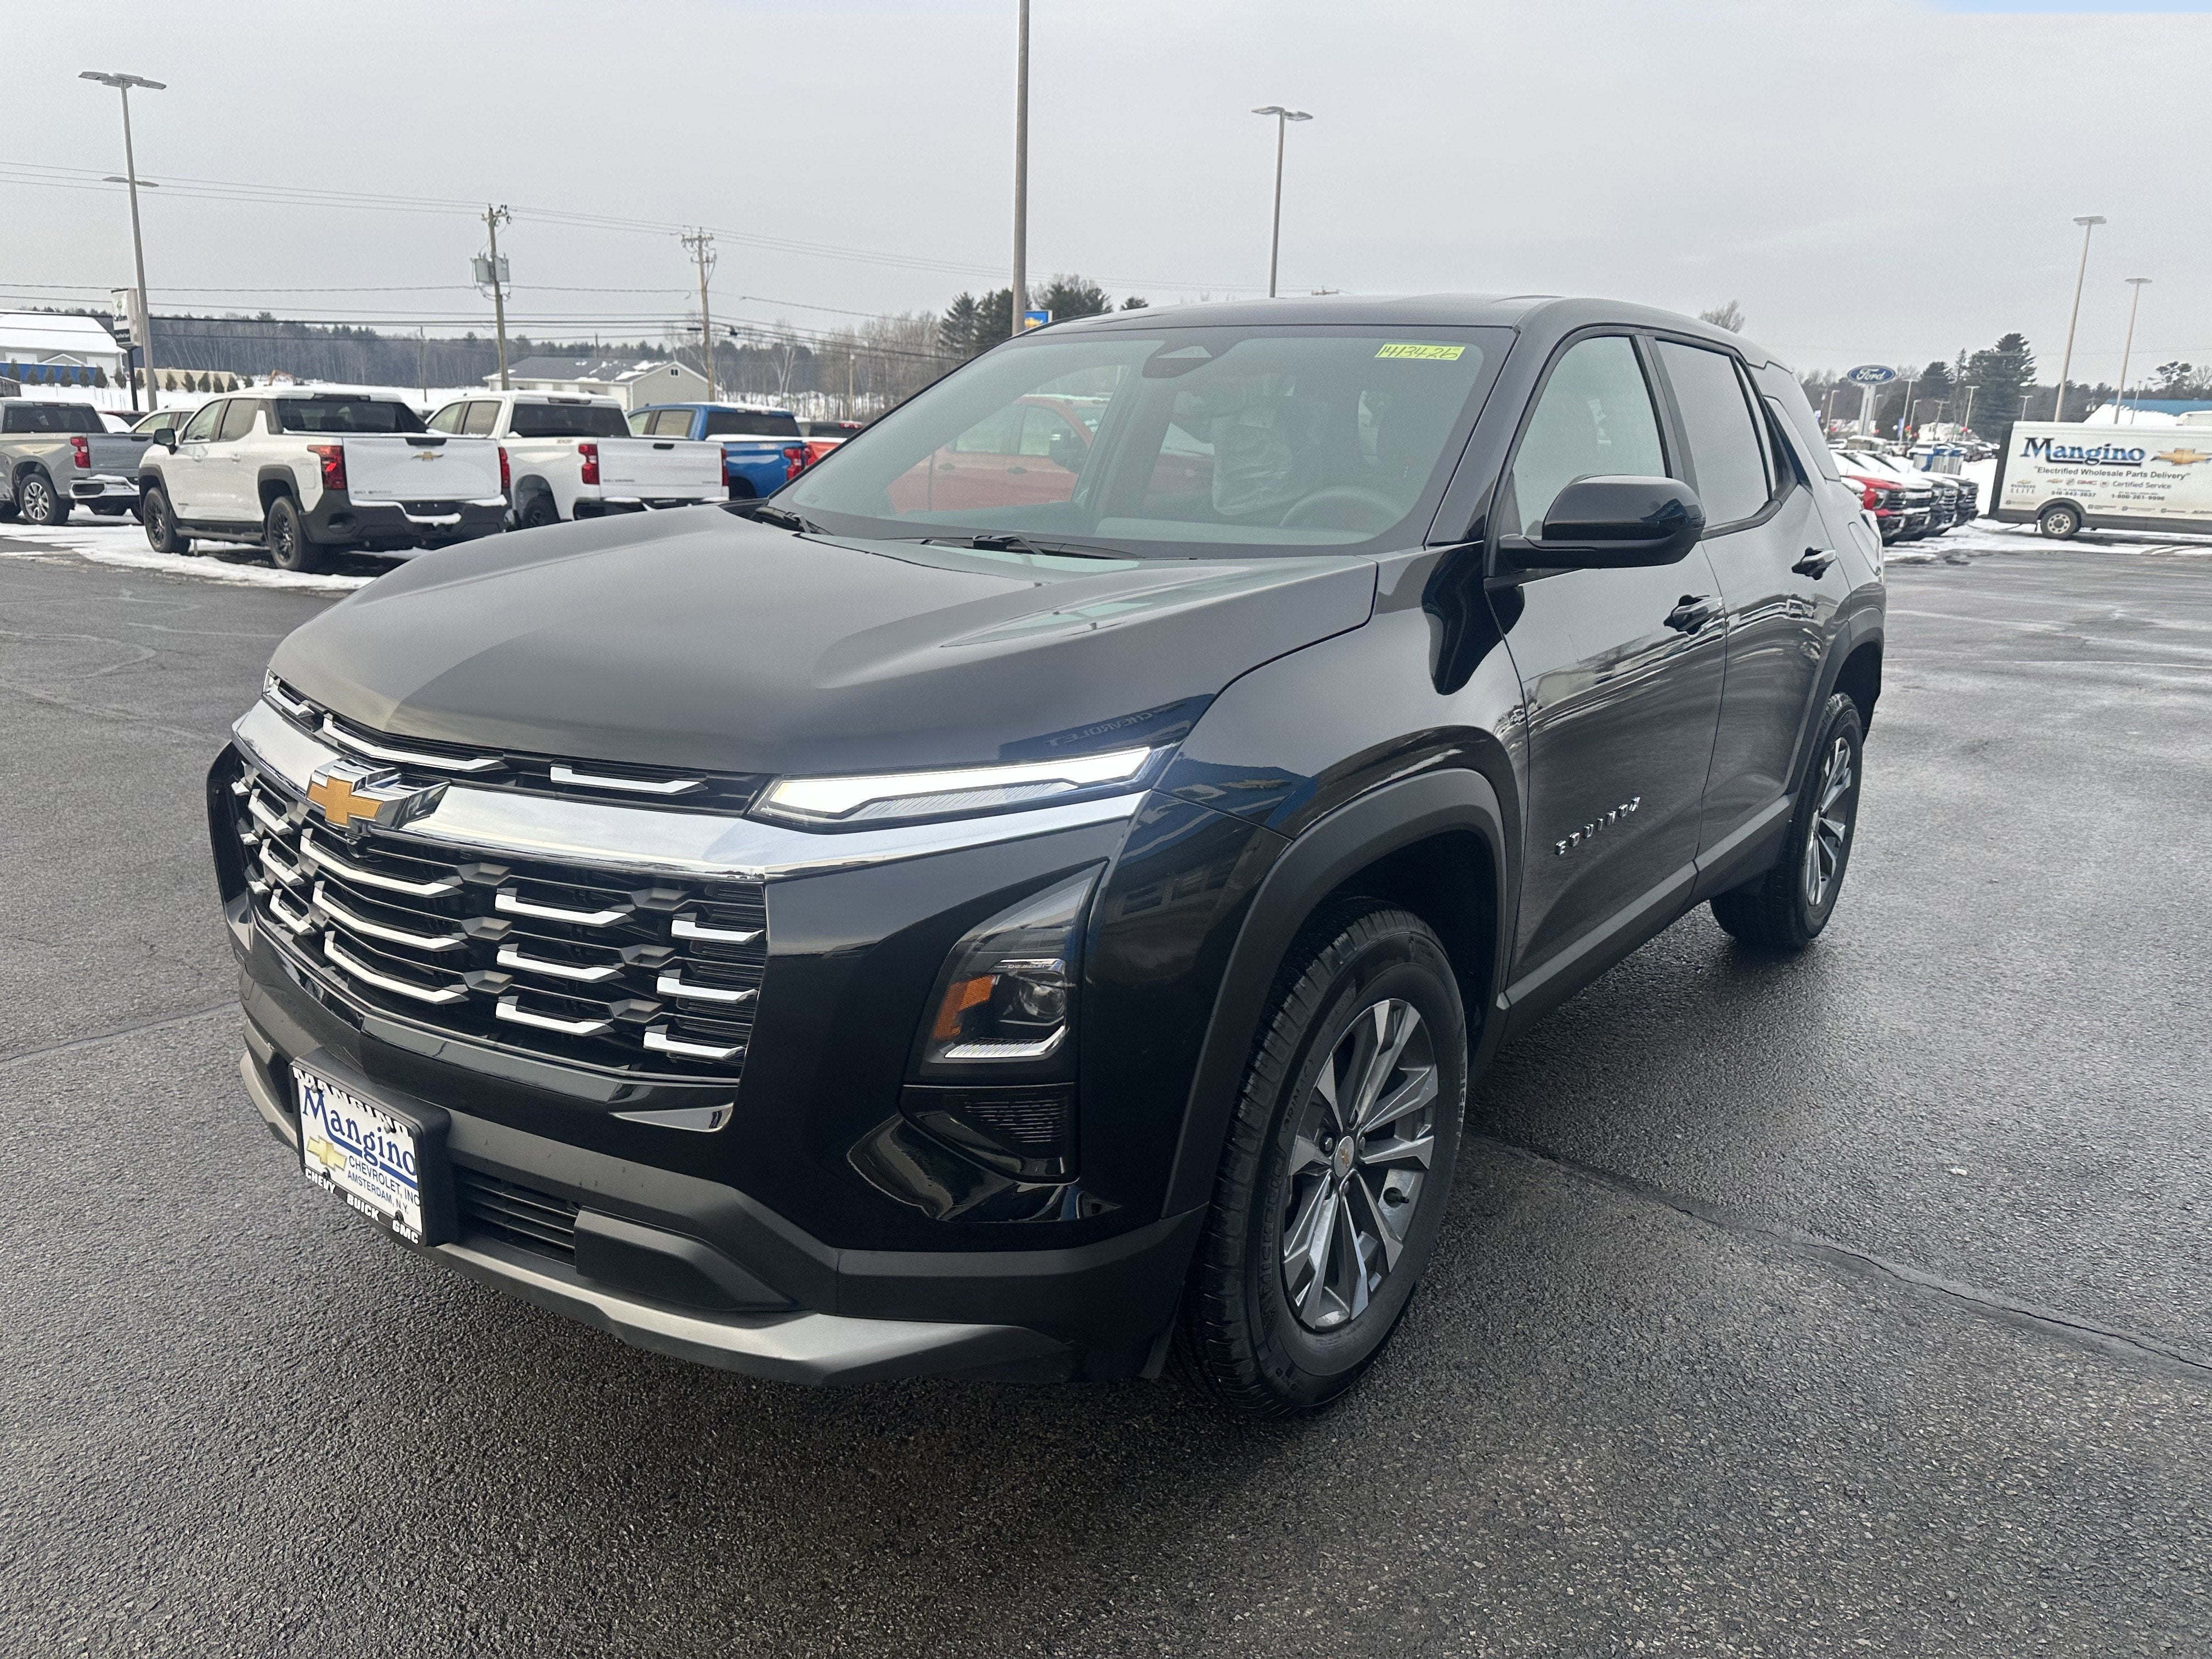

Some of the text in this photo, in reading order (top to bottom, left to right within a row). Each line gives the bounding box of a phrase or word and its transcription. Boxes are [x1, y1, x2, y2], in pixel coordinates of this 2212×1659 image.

[1857, 367, 1886, 380] Ford
[2019, 437, 2146, 466] Mangino
[2081, 469, 2124, 477] Wholesale
[2125, 470, 2148, 478] Parts
[302, 1085, 416, 1176] Mangino
[347, 1170, 409, 1215] AMSTERDAM, N.Y.
[349, 1155, 402, 1198] CHEVROLET,
[305, 1167, 419, 1244] CHEVY BUICK GMC
